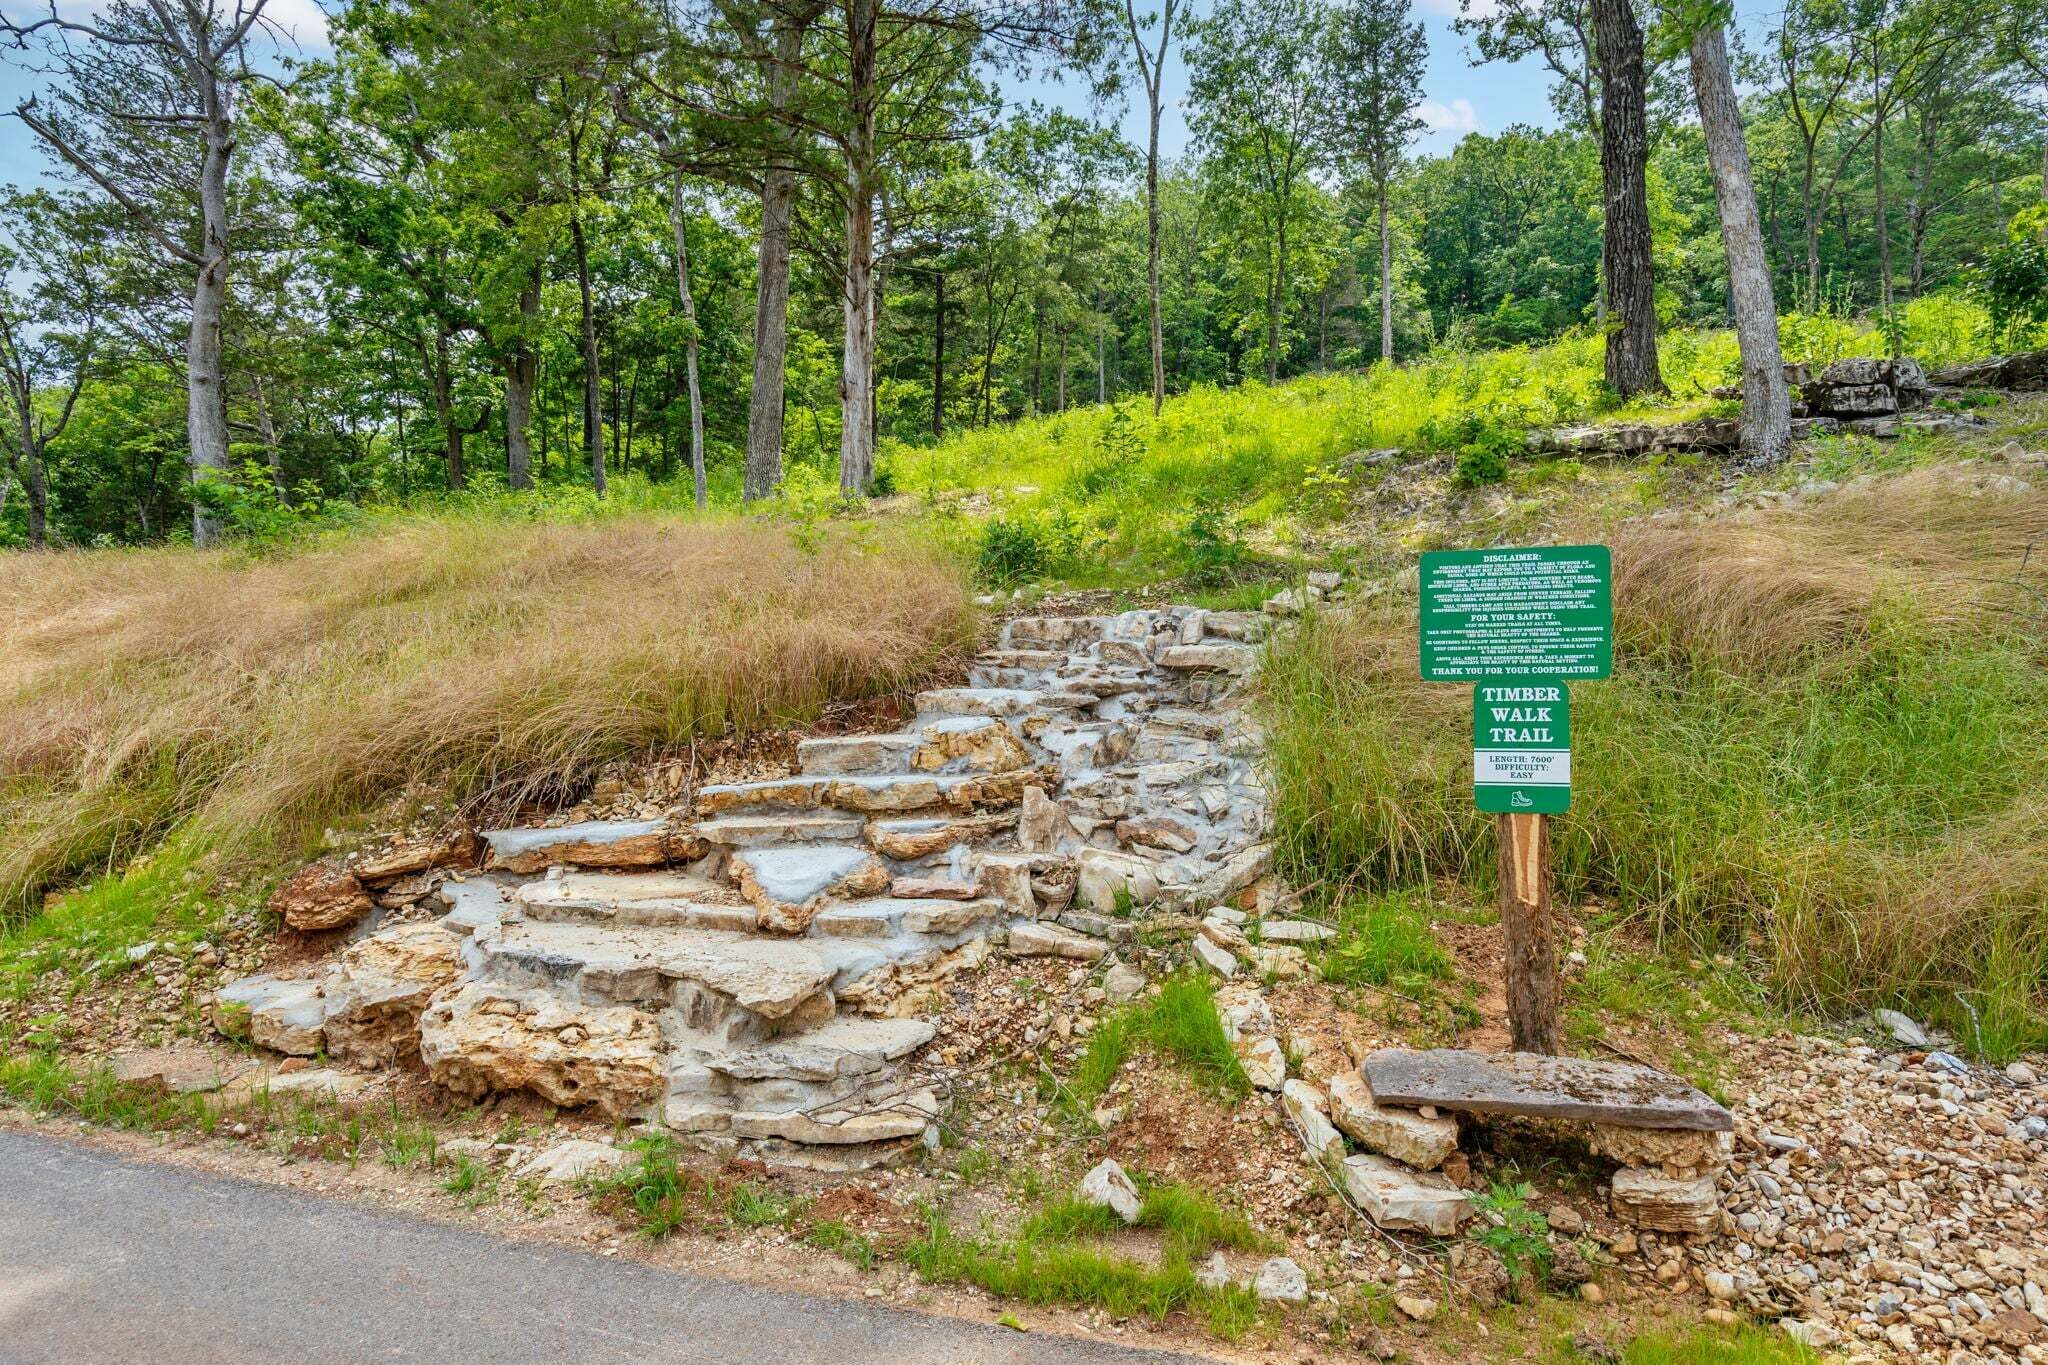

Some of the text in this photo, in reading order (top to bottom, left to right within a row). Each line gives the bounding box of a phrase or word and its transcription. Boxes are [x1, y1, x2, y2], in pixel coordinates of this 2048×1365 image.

[1483, 554, 1541, 562] DISCLAIMER:
[1517, 612, 1556, 620] SAFETY:
[1482, 687, 1560, 702] TIMBER
[1490, 708, 1552, 722] WALK
[1490, 728, 1554, 742] TRAIL
